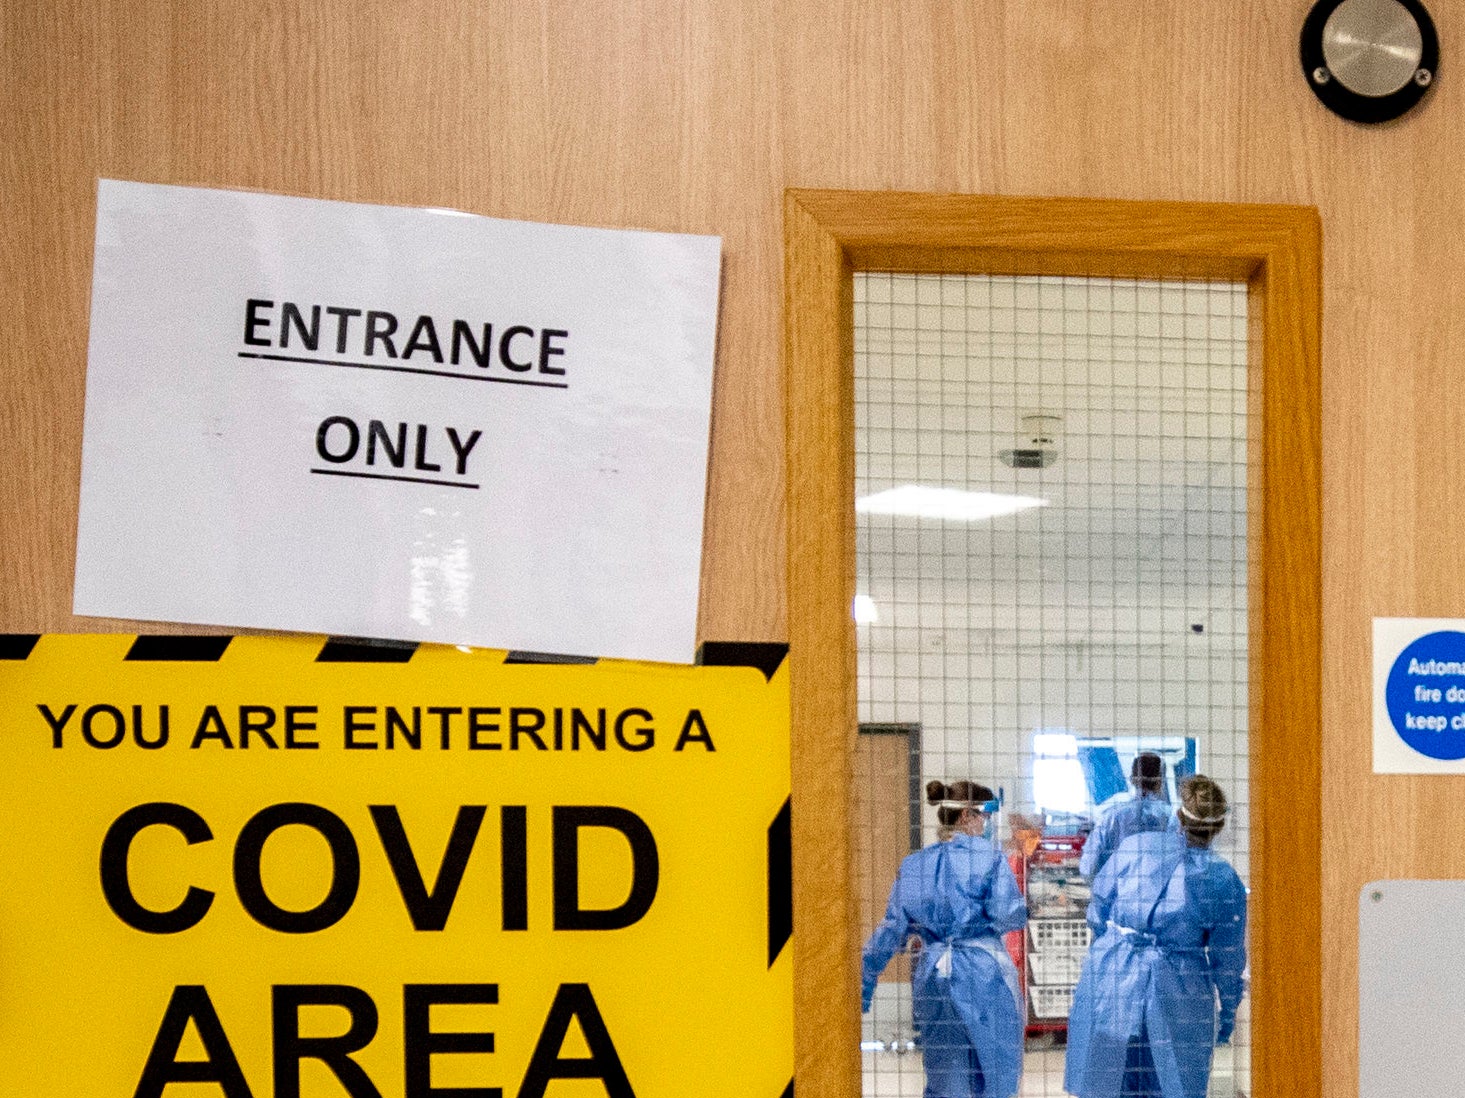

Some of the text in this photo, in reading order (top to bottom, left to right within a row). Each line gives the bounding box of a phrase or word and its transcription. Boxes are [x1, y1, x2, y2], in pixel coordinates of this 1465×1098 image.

[242, 298, 570, 376] ENTRANCE
[315, 415, 482, 475] ONLY
[1405, 712, 1447, 732] keep
[1414, 686, 1442, 703] fire
[35, 703, 717, 754] YOU ARE ENTERING A
[98, 800, 662, 936] COVID
